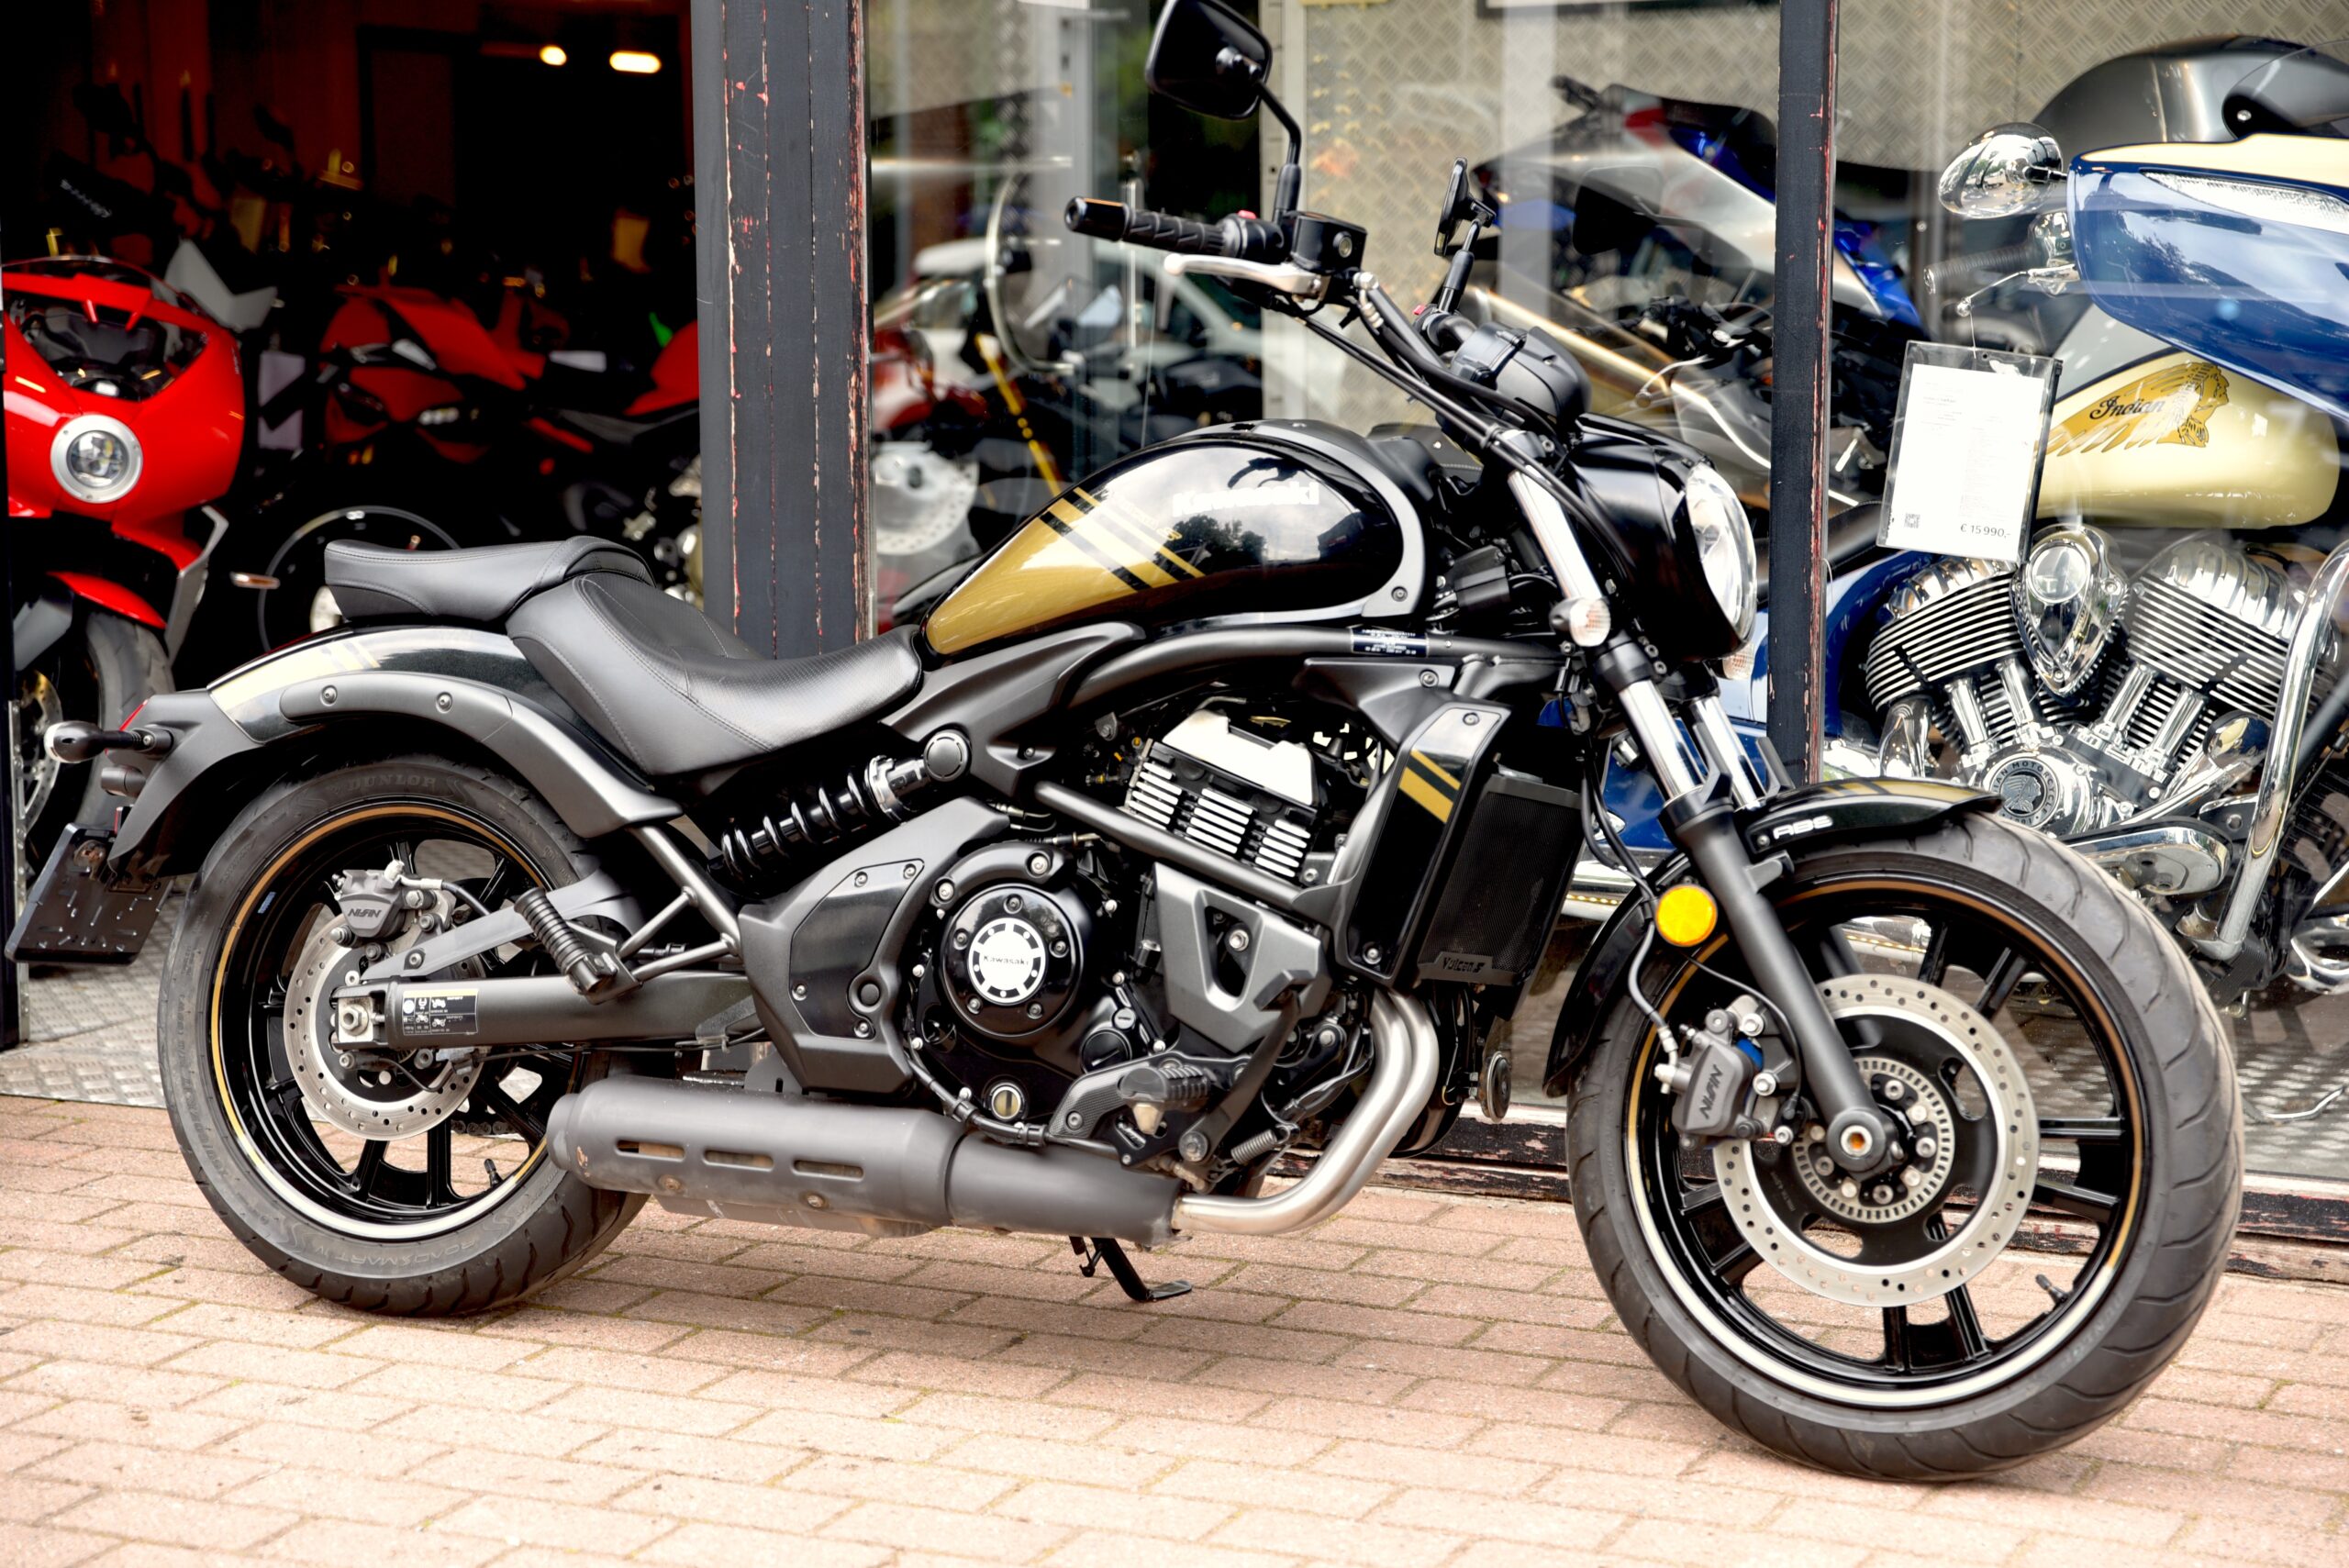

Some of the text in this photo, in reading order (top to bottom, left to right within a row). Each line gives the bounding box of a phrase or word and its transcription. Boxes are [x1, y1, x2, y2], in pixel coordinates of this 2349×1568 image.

[2089, 395, 2166, 420] Indian
[1960, 523, 1967, 533] €
[347, 773, 437, 792] DUNLOP
[2011, 761, 2055, 815] MOTORCYCLE
[1773, 815, 1833, 840] ABS
[348, 908, 382, 918] NISSIN
[984, 955, 1029, 965] Kawasaki
[1699, 1064, 1723, 1119] NISSIN
